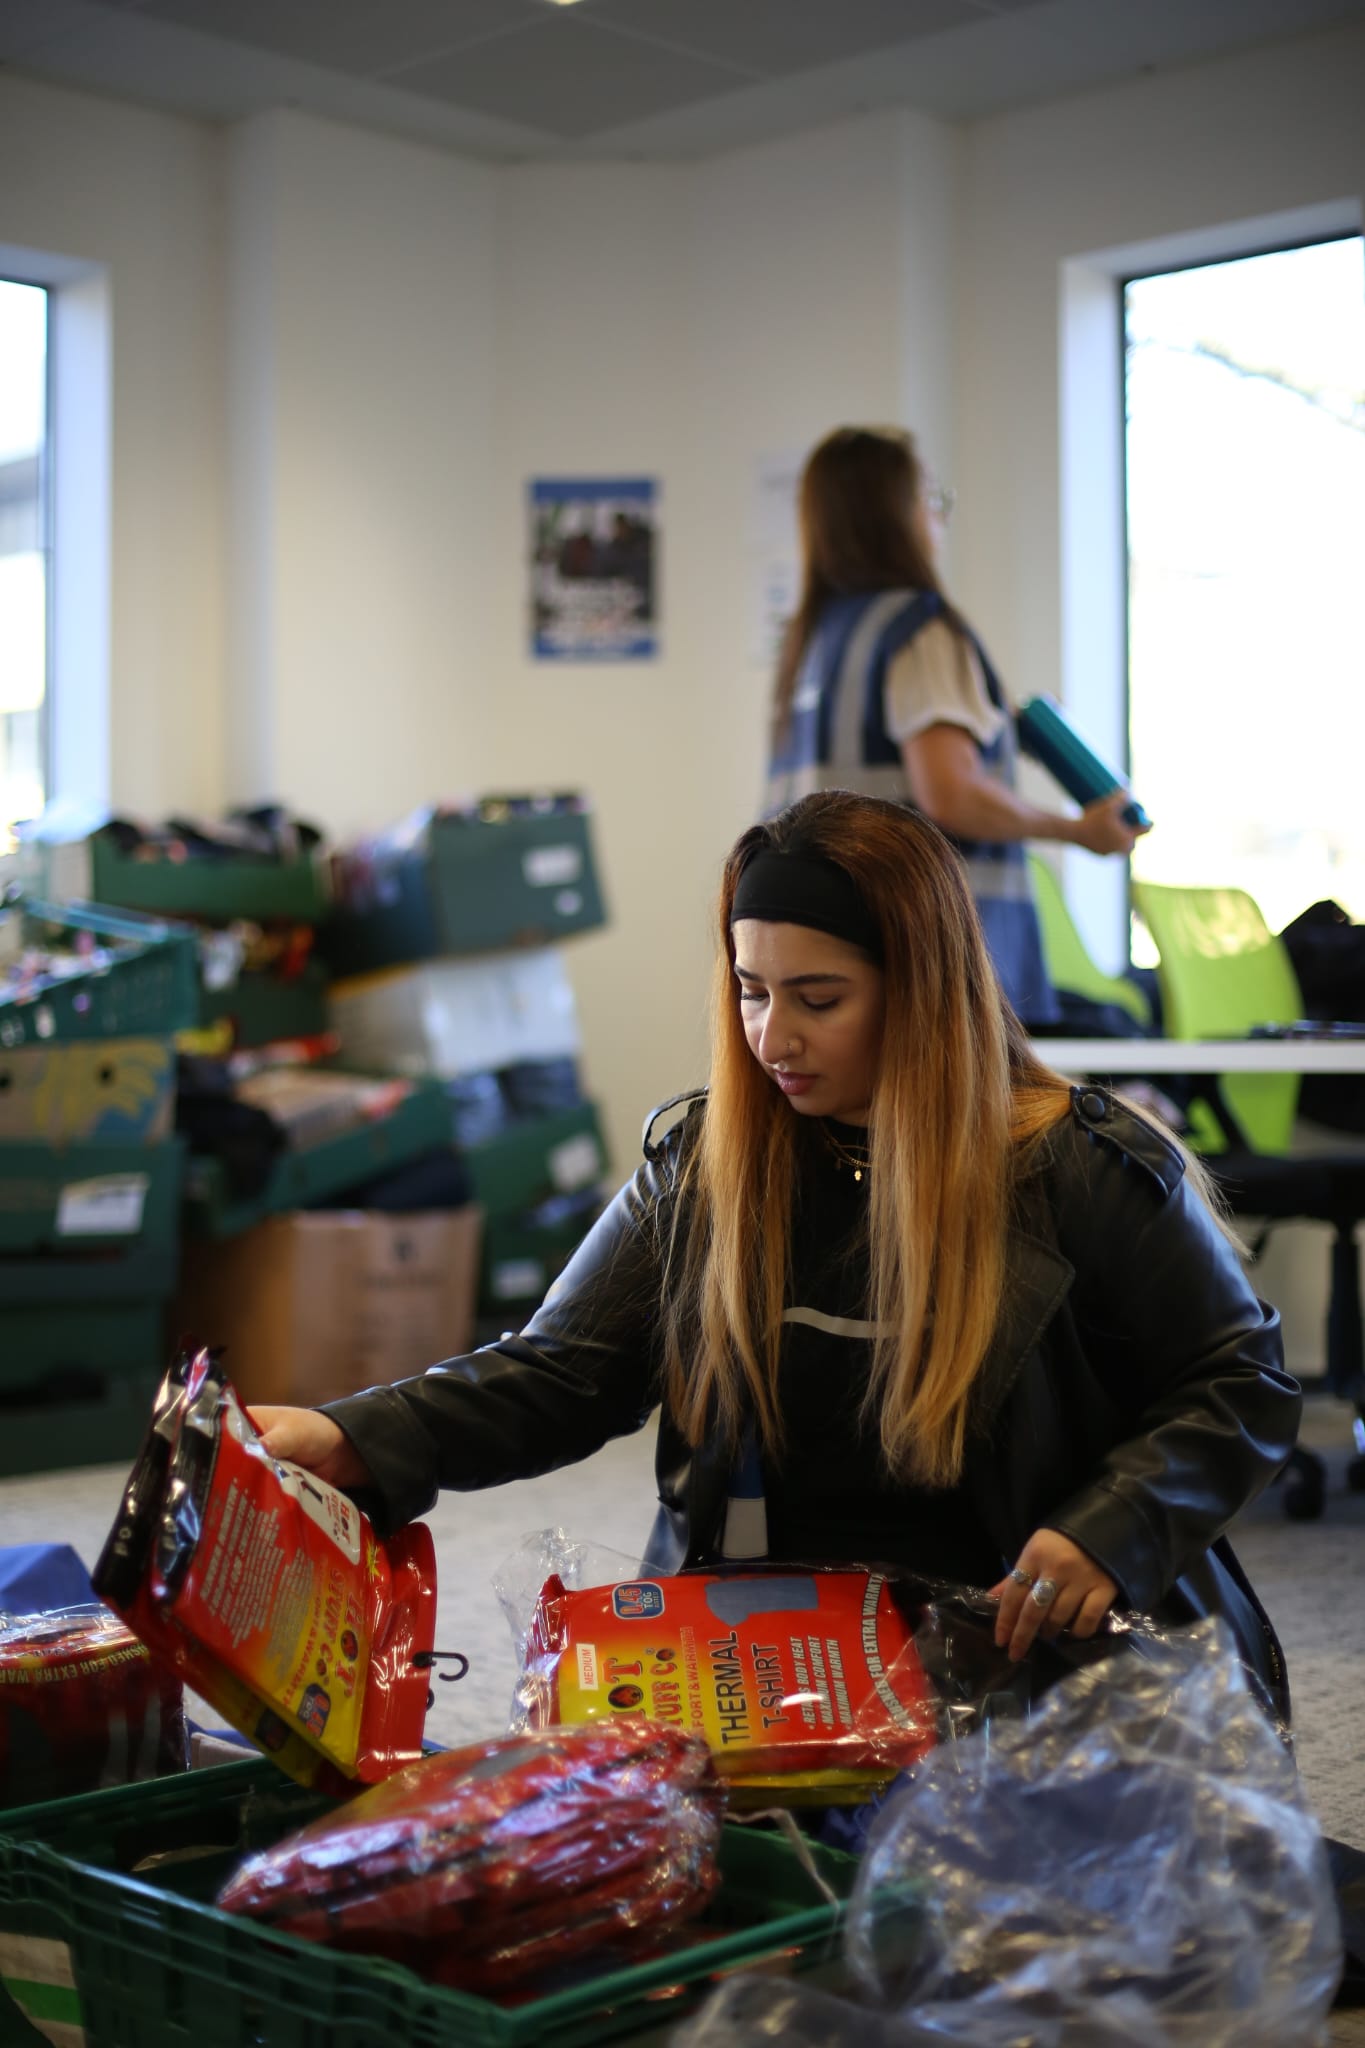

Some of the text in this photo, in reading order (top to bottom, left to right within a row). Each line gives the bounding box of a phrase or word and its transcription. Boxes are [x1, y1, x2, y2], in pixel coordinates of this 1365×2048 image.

[618, 1588, 644, 1615] 0.45
[643, 1591, 654, 1609] TOG
[861, 1618, 879, 1654] EXTRA
[35, 1664, 78, 1682] EXTRA
[80, 1657, 108, 1676] FOR
[582, 1649, 595, 1685] MEDIUM
[808, 1635, 826, 1679] COMFORT
[866, 1655, 885, 1680] FOR
[708, 1630, 751, 1745] THERMAL
[751, 1642, 789, 1729] T-SHIRT
[790, 1636, 817, 1724] RETAS BODY HEAT
[825, 1638, 853, 1726] MAXIMUM WARMTH
